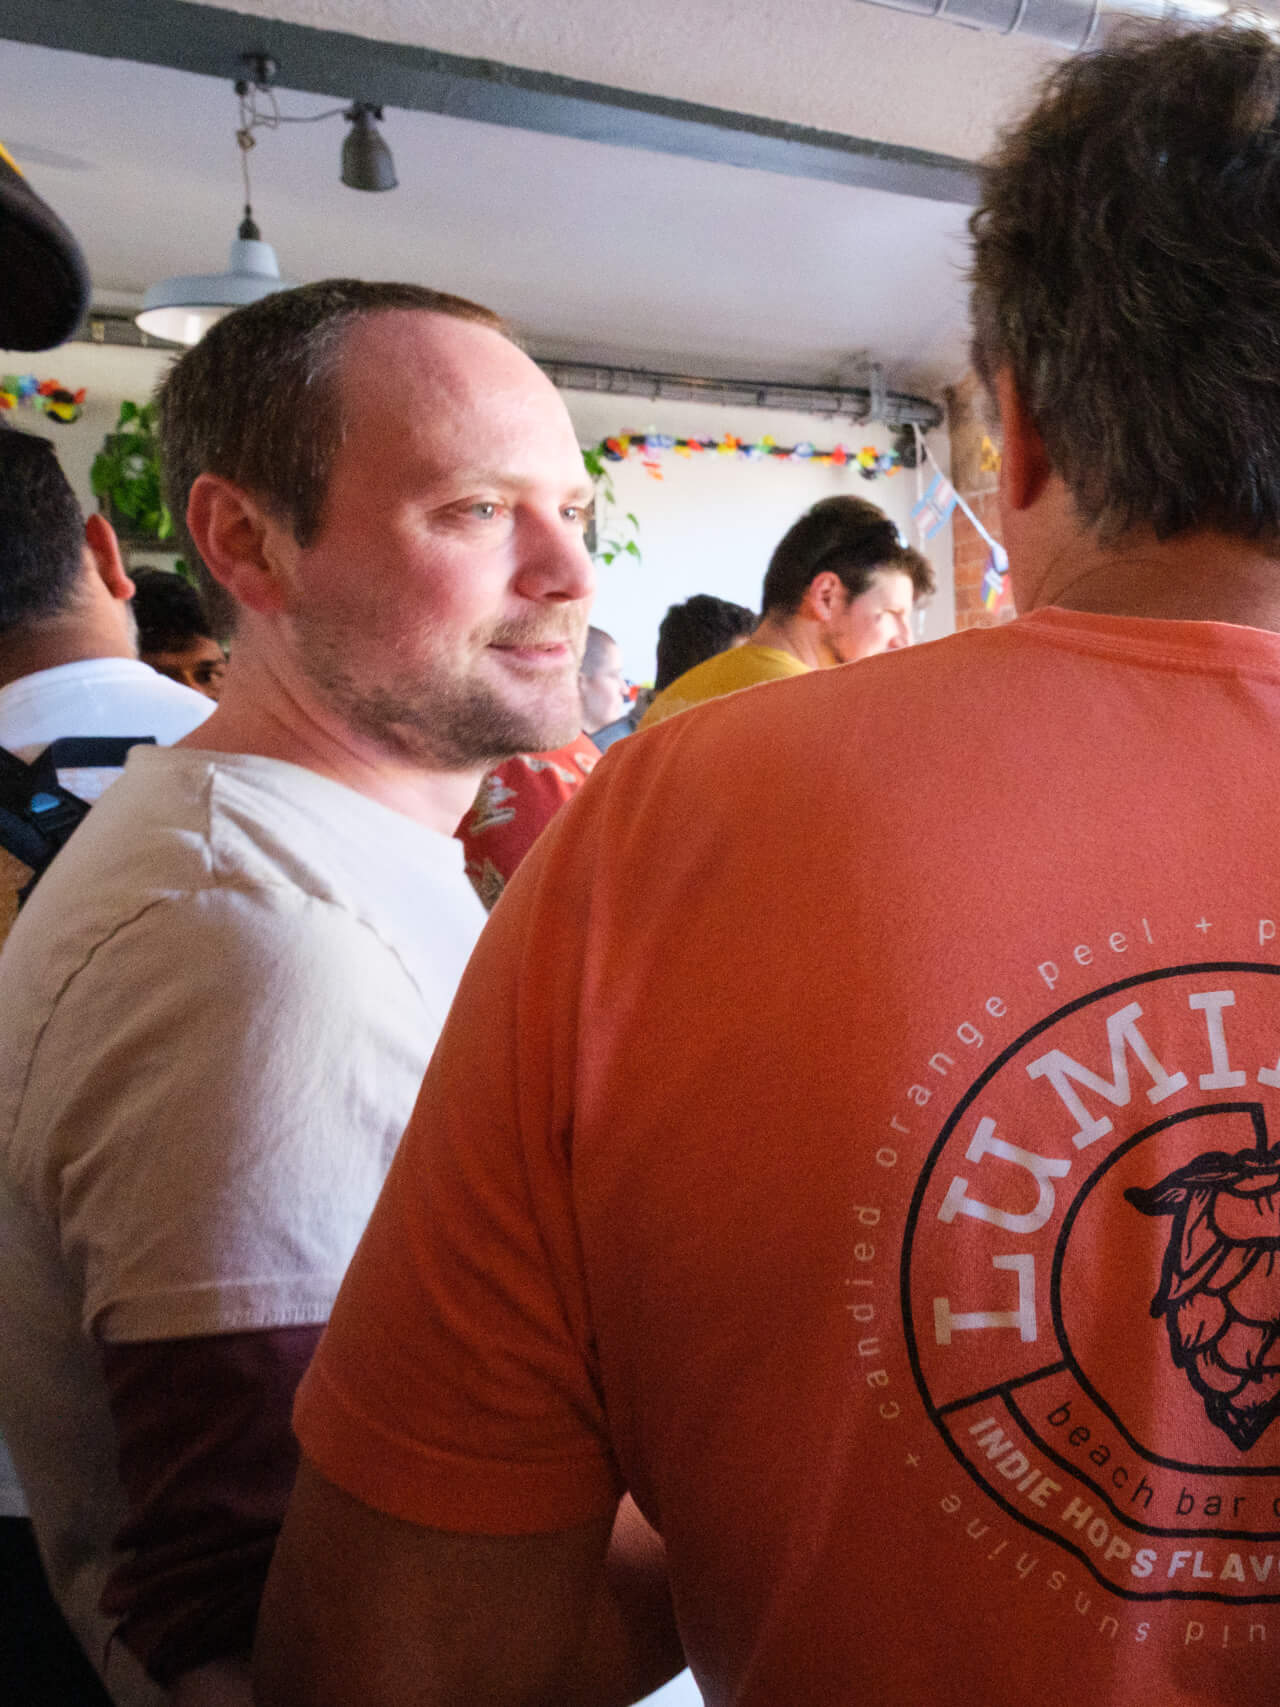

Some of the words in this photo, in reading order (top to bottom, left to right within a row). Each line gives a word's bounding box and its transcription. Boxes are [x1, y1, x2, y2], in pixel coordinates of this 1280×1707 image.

[1038, 918, 1154, 990] peel
[876, 995, 1008, 1168] orange
[845, 1204, 900, 1420] candied
[968, 1417, 1062, 1508] INDIE
[1061, 1497, 1157, 1578] HOPS
[1047, 1401, 1154, 1510] beach
[1175, 1487, 1247, 1516] bar
[941, 1495, 1150, 1643] sunshine
